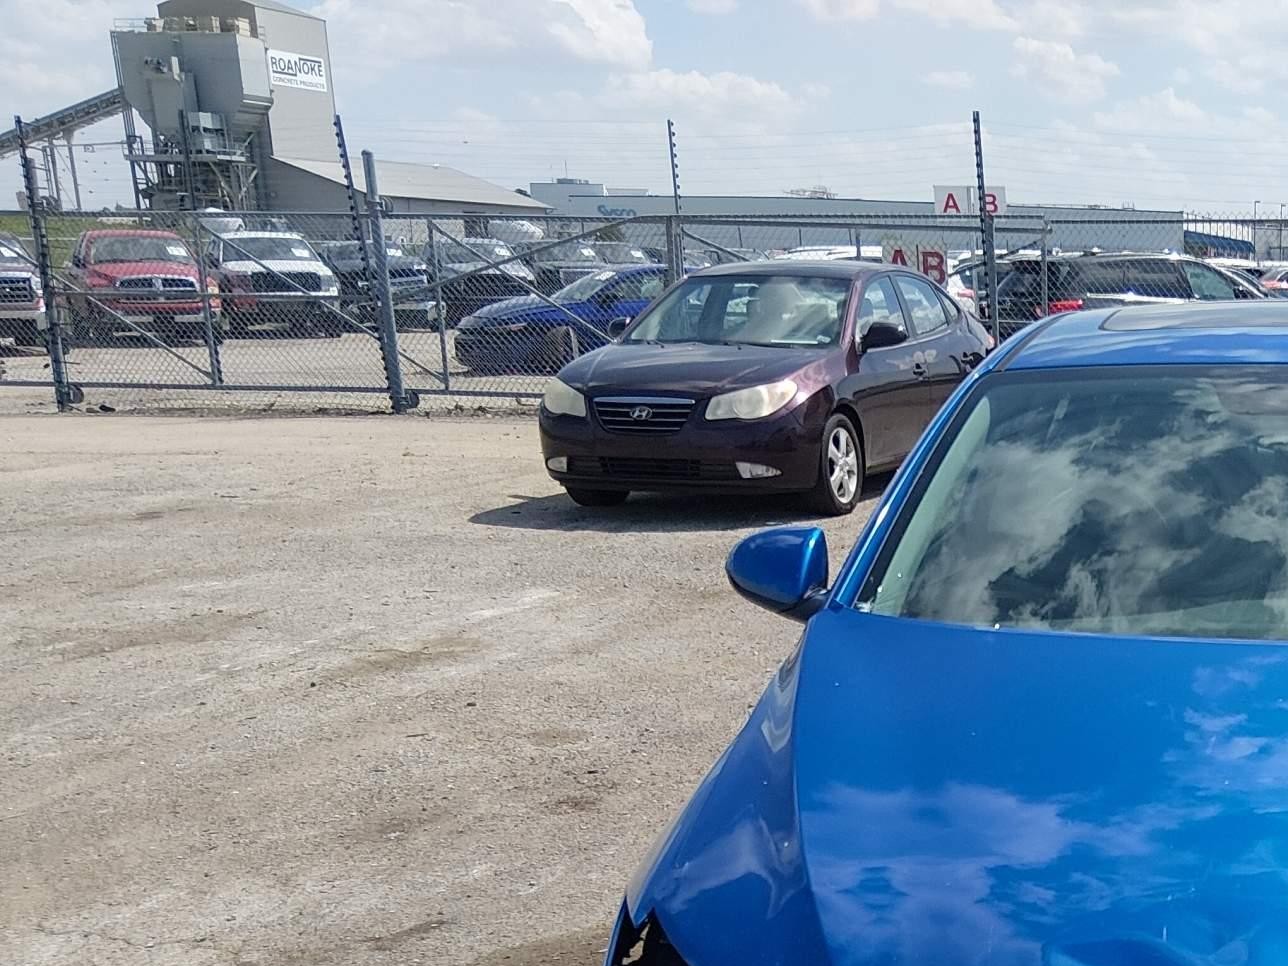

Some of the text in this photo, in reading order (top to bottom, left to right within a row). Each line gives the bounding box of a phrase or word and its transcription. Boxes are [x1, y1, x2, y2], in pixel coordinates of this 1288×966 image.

[270, 56, 324, 77] ROANOKE
[943, 193, 998, 214] A B
[920, 251, 946, 287] B
